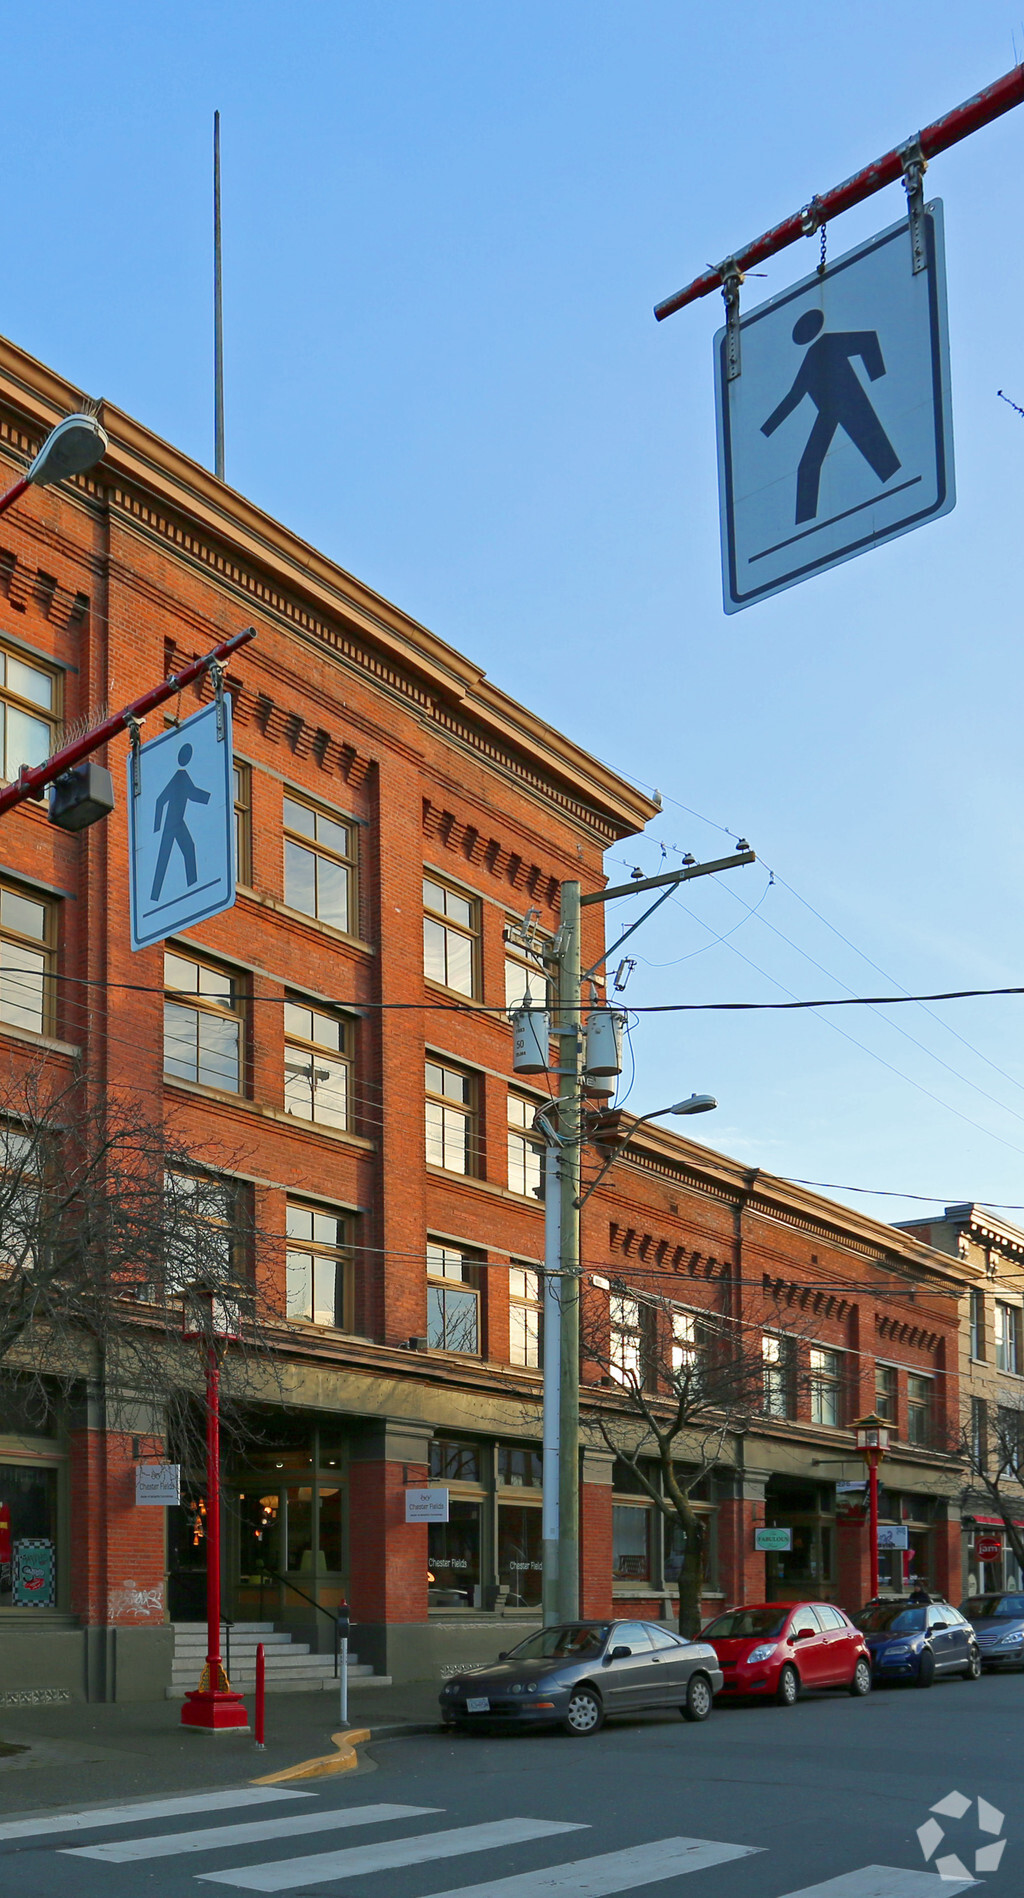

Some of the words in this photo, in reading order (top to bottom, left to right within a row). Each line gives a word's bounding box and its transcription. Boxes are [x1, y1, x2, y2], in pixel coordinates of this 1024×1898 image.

[409, 1503, 429, 1511] Chester
[429, 1558, 451, 1568] Chester
[451, 1558, 467, 1568] Fields
[510, 1561, 530, 1570] Chester
[531, 1561, 542, 1570] Field
